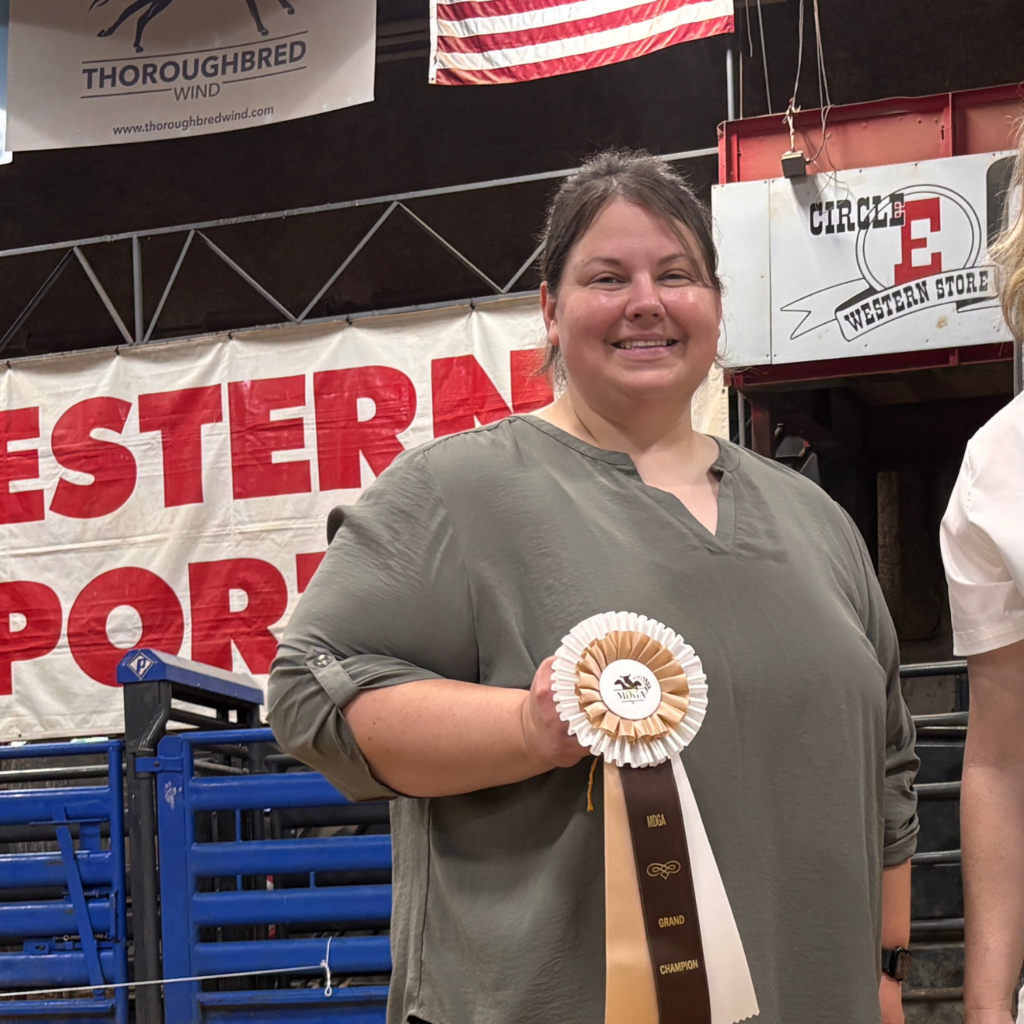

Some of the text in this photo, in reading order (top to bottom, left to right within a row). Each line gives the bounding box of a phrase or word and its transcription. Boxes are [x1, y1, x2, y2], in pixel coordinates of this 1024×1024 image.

[82, 41, 306, 90] THOROUGHBRED
[174, 82, 220, 101] WIND
[113, 106, 274, 135] www.thoroughbredwind.com
[809, 192, 942, 286] CIRCLE E
[844, 270, 989, 332] WESTERN STORE
[0, 552, 327, 696] POR
[646, 814, 666, 828] MDGA
[658, 915, 685, 928] GRAND
[660, 959, 698, 975] CHAMPION
